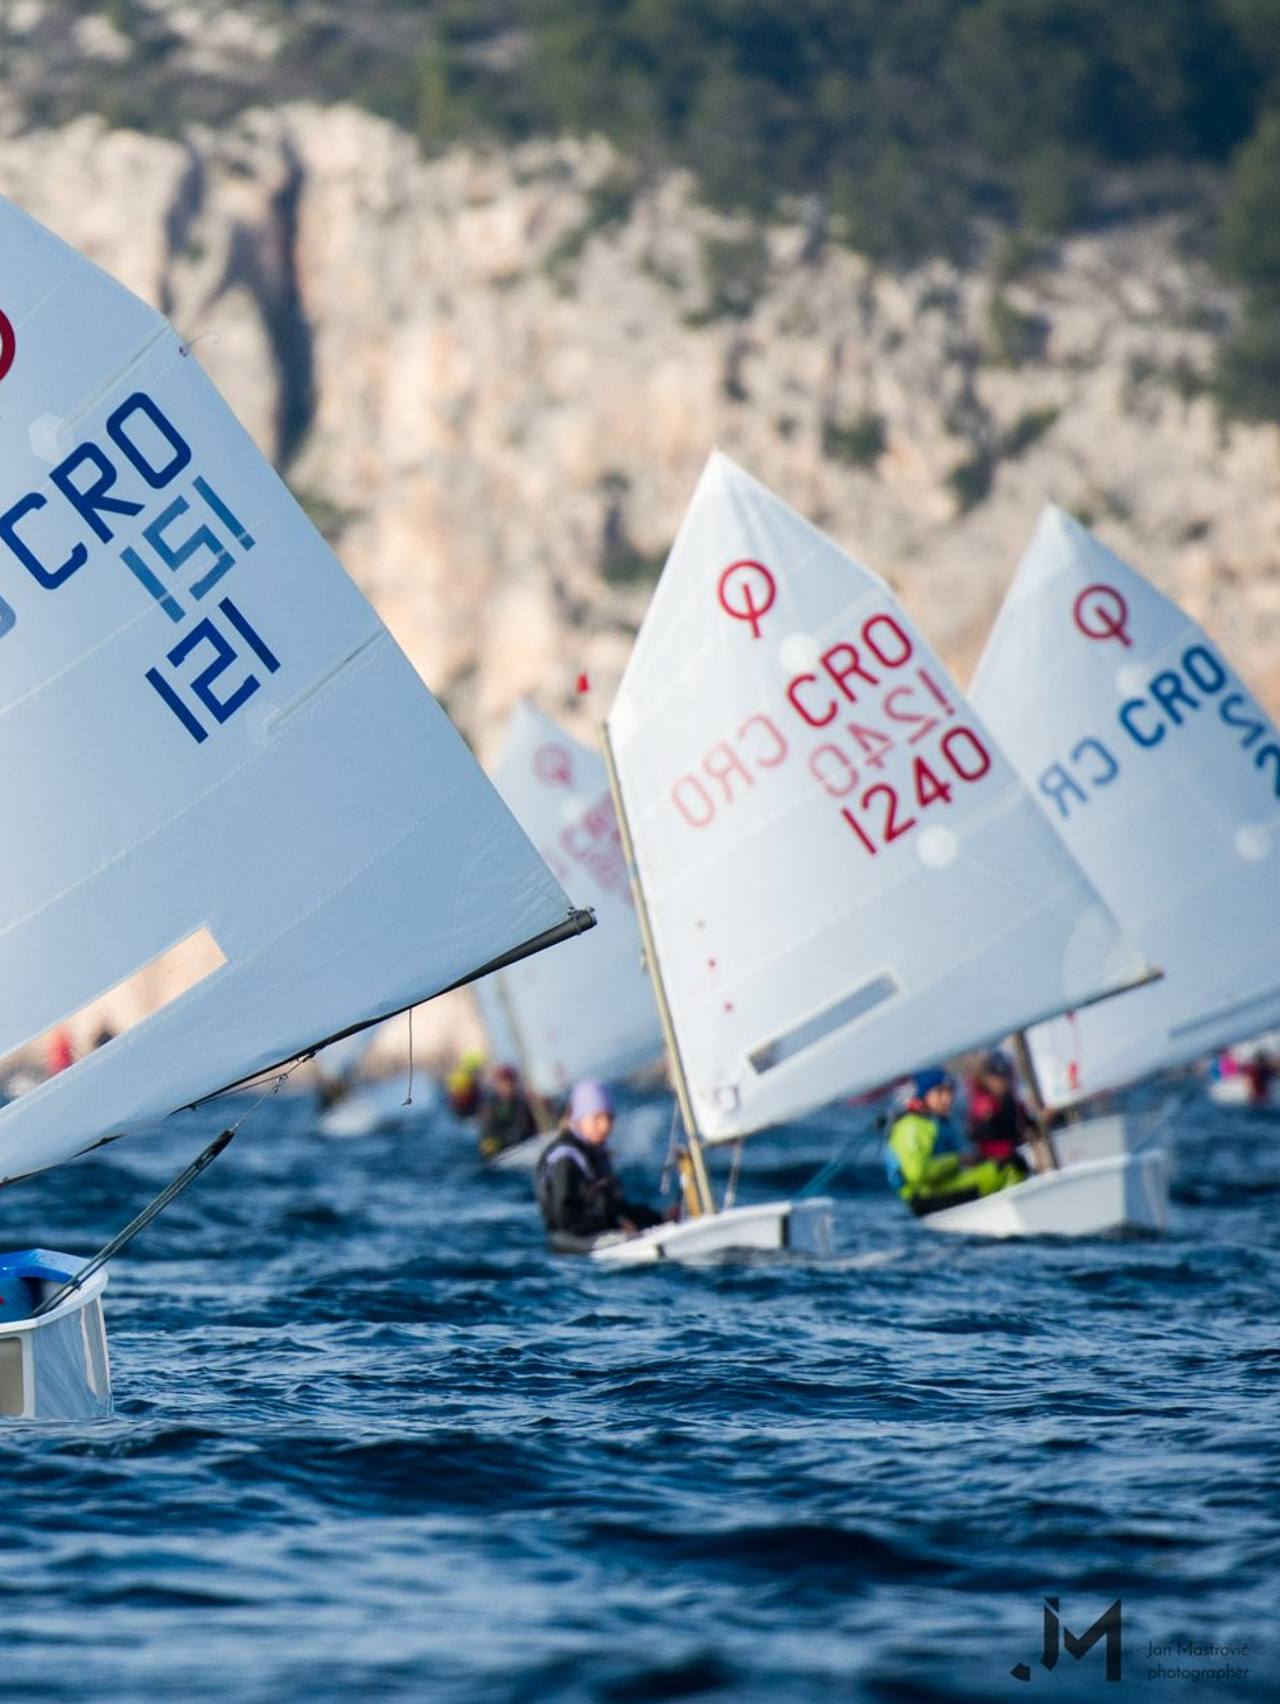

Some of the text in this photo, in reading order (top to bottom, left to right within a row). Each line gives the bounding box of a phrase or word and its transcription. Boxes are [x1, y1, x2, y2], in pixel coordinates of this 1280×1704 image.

[144, 597, 281, 744] 121
[786, 614, 913, 728] CRO
[1118, 645, 1227, 748] CRO
[841, 726, 991, 855] 1240
